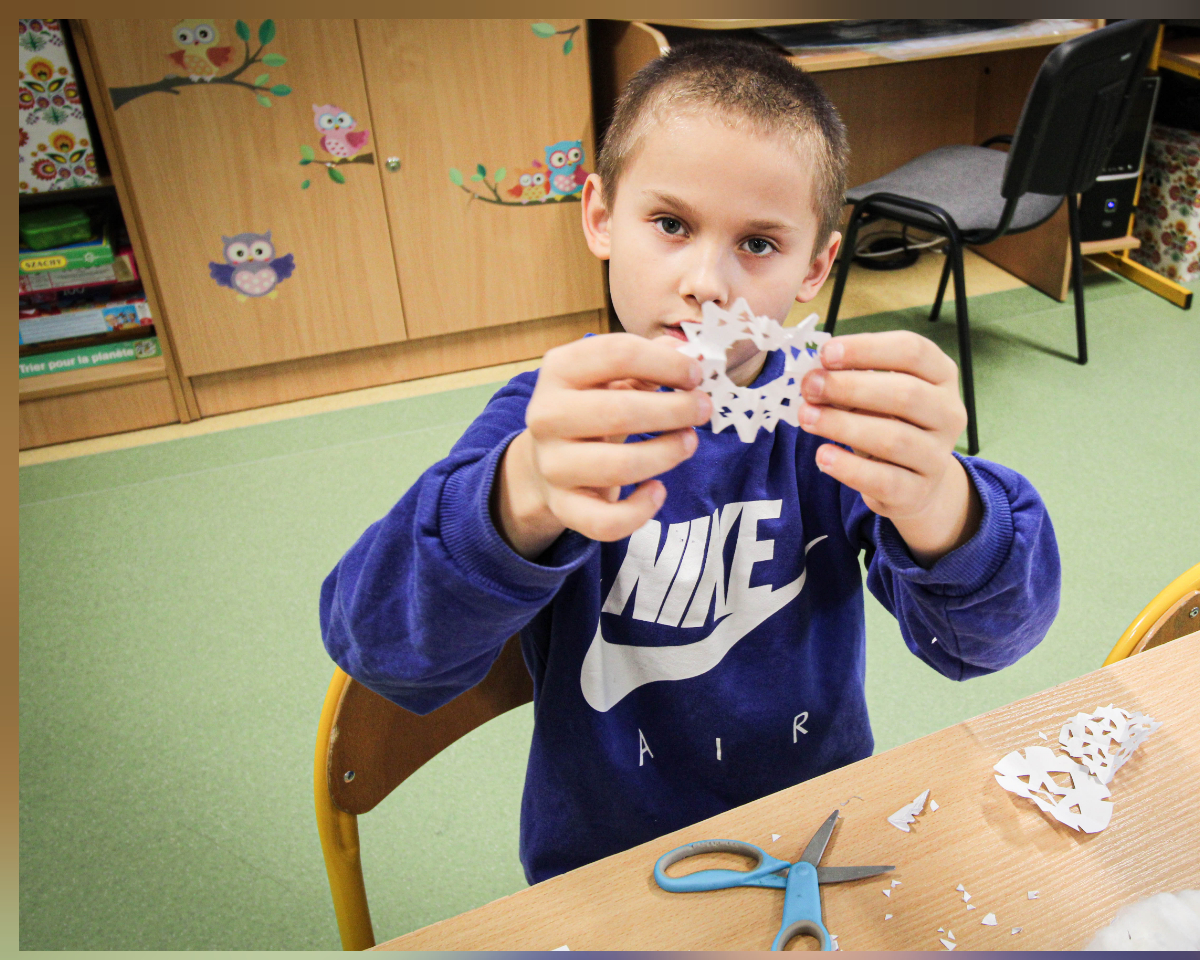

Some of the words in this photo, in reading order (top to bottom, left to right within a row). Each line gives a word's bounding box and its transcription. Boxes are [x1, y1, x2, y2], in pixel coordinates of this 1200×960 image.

[19, 362, 46, 374] Trier
[48, 357, 76, 371] pour
[77, 353, 90, 364] la
[91, 347, 134, 364] planète
[601, 499, 783, 628] NIKE
